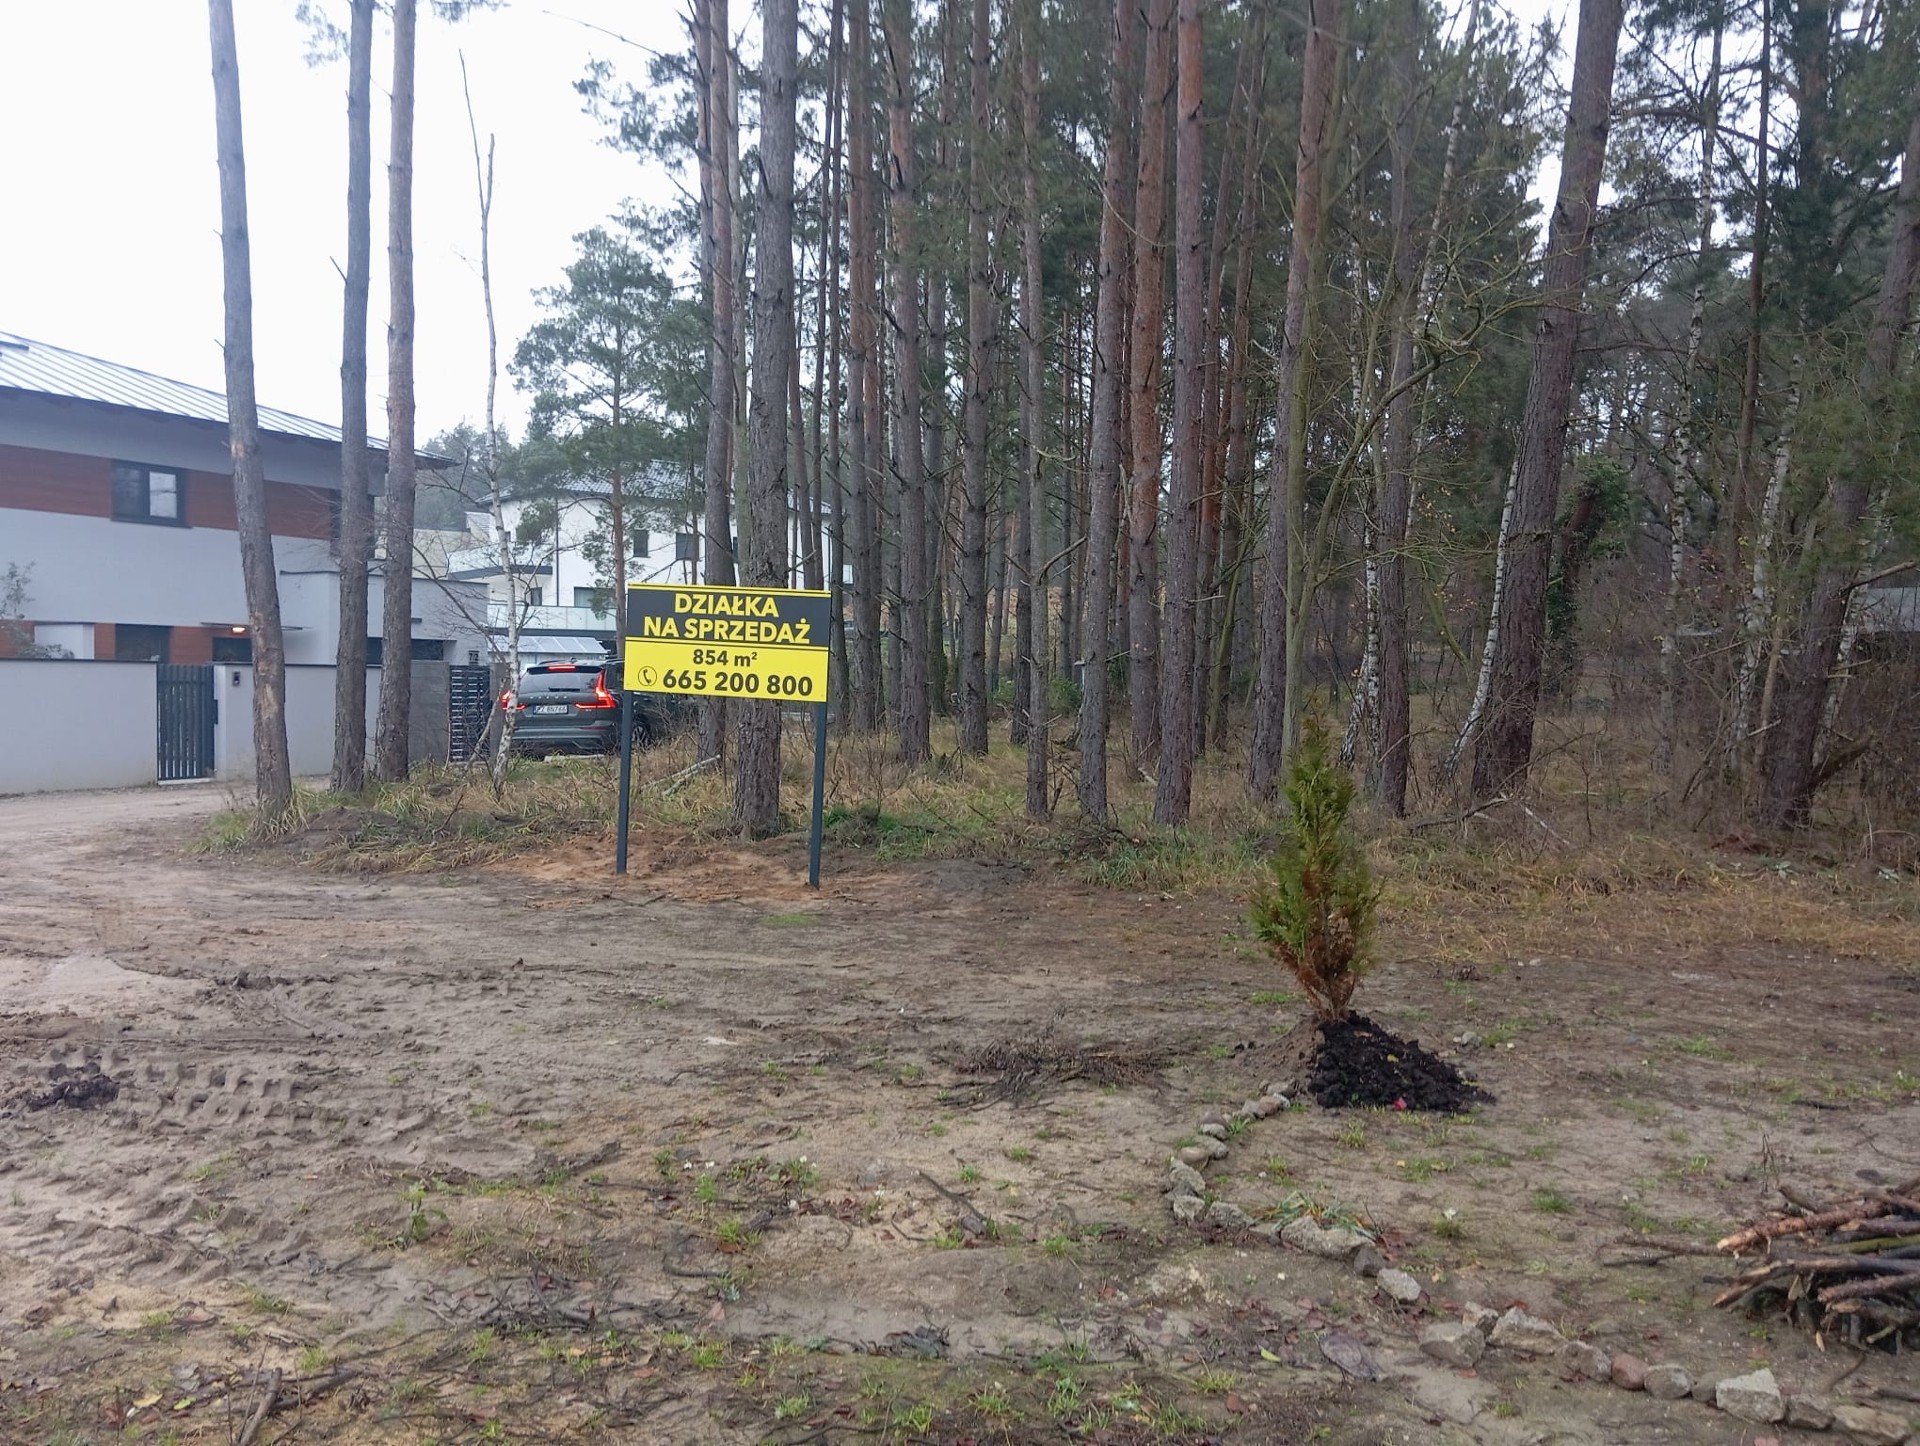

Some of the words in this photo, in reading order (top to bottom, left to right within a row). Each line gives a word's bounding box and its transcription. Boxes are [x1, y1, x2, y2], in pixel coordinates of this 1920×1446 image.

[674, 593, 779, 618] DZIAŁKA
[644, 616, 680, 639] NA
[684, 618, 811, 644] SPRZEDAŻ
[693, 649, 729, 666] 854
[663, 669, 707, 690] 665
[714, 671, 760, 693] 200
[766, 674, 813, 696] 800
